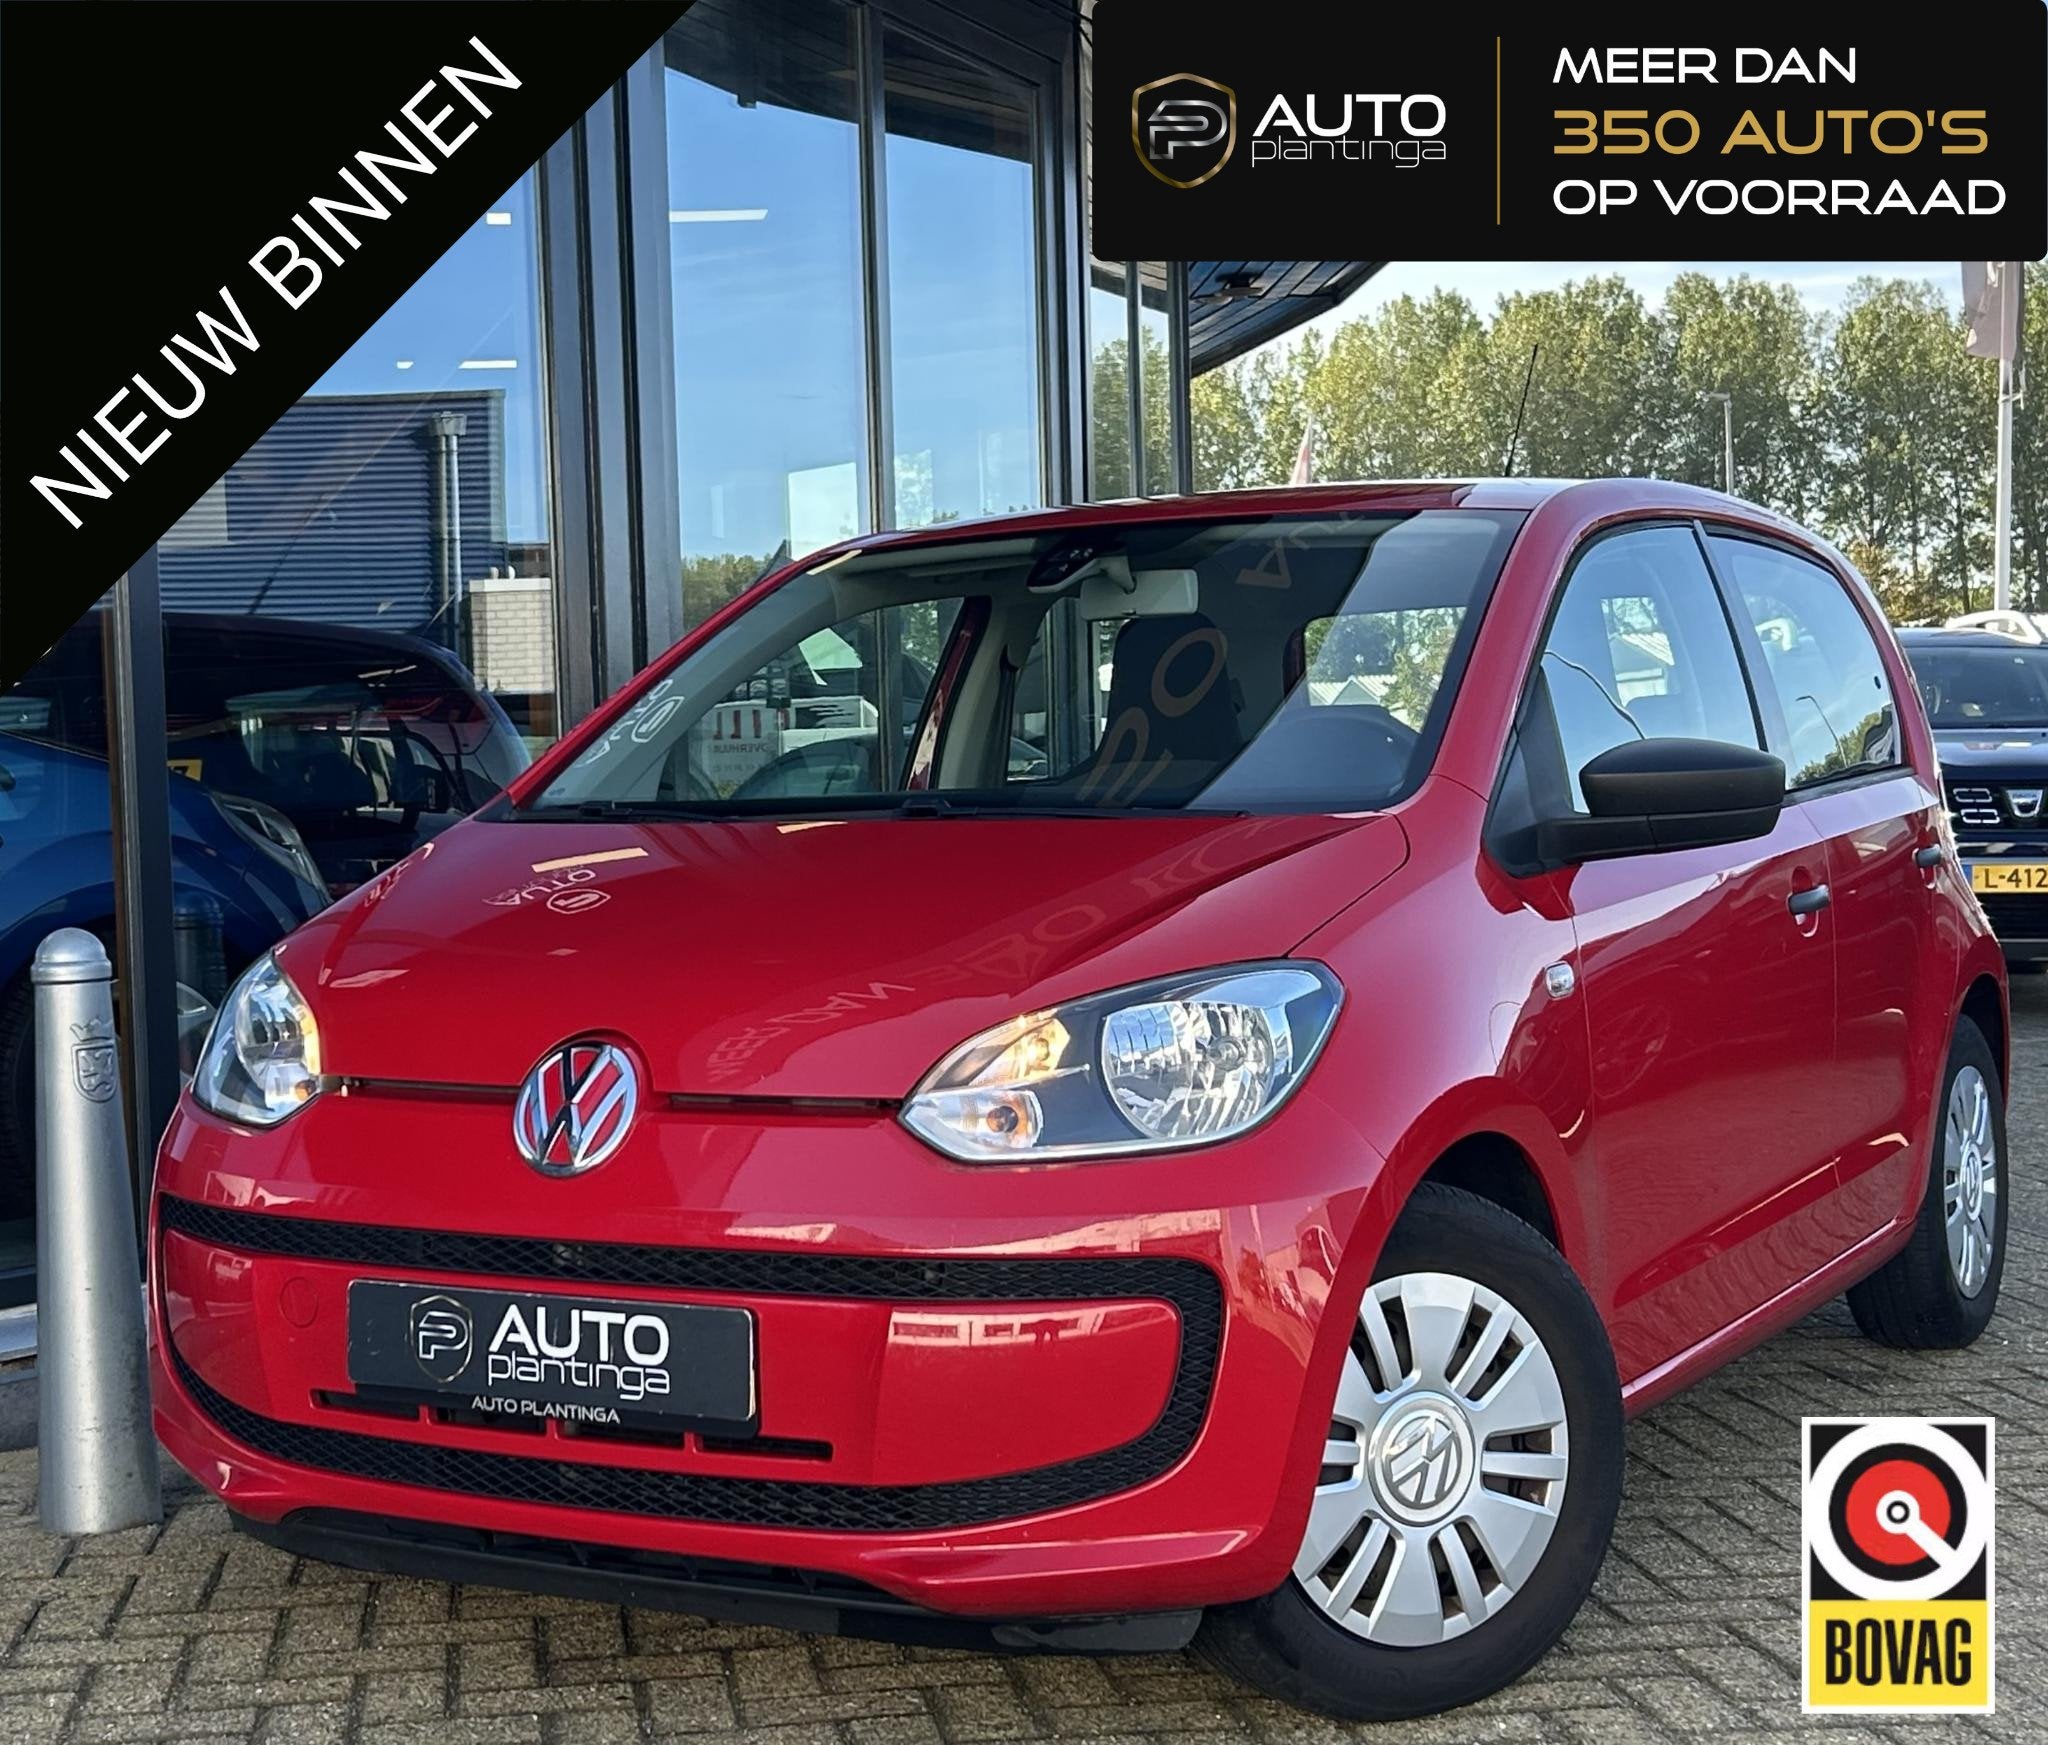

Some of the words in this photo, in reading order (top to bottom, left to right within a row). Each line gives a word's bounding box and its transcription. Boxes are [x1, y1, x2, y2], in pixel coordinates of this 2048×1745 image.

[1984, 868, 2048, 888] L-412
[488, 1304, 671, 1367] AUTO
[487, 1355, 671, 1401] plantinga
[471, 1395, 518, 1414] AUTO
[520, 1400, 621, 1424] PLANTINGA
